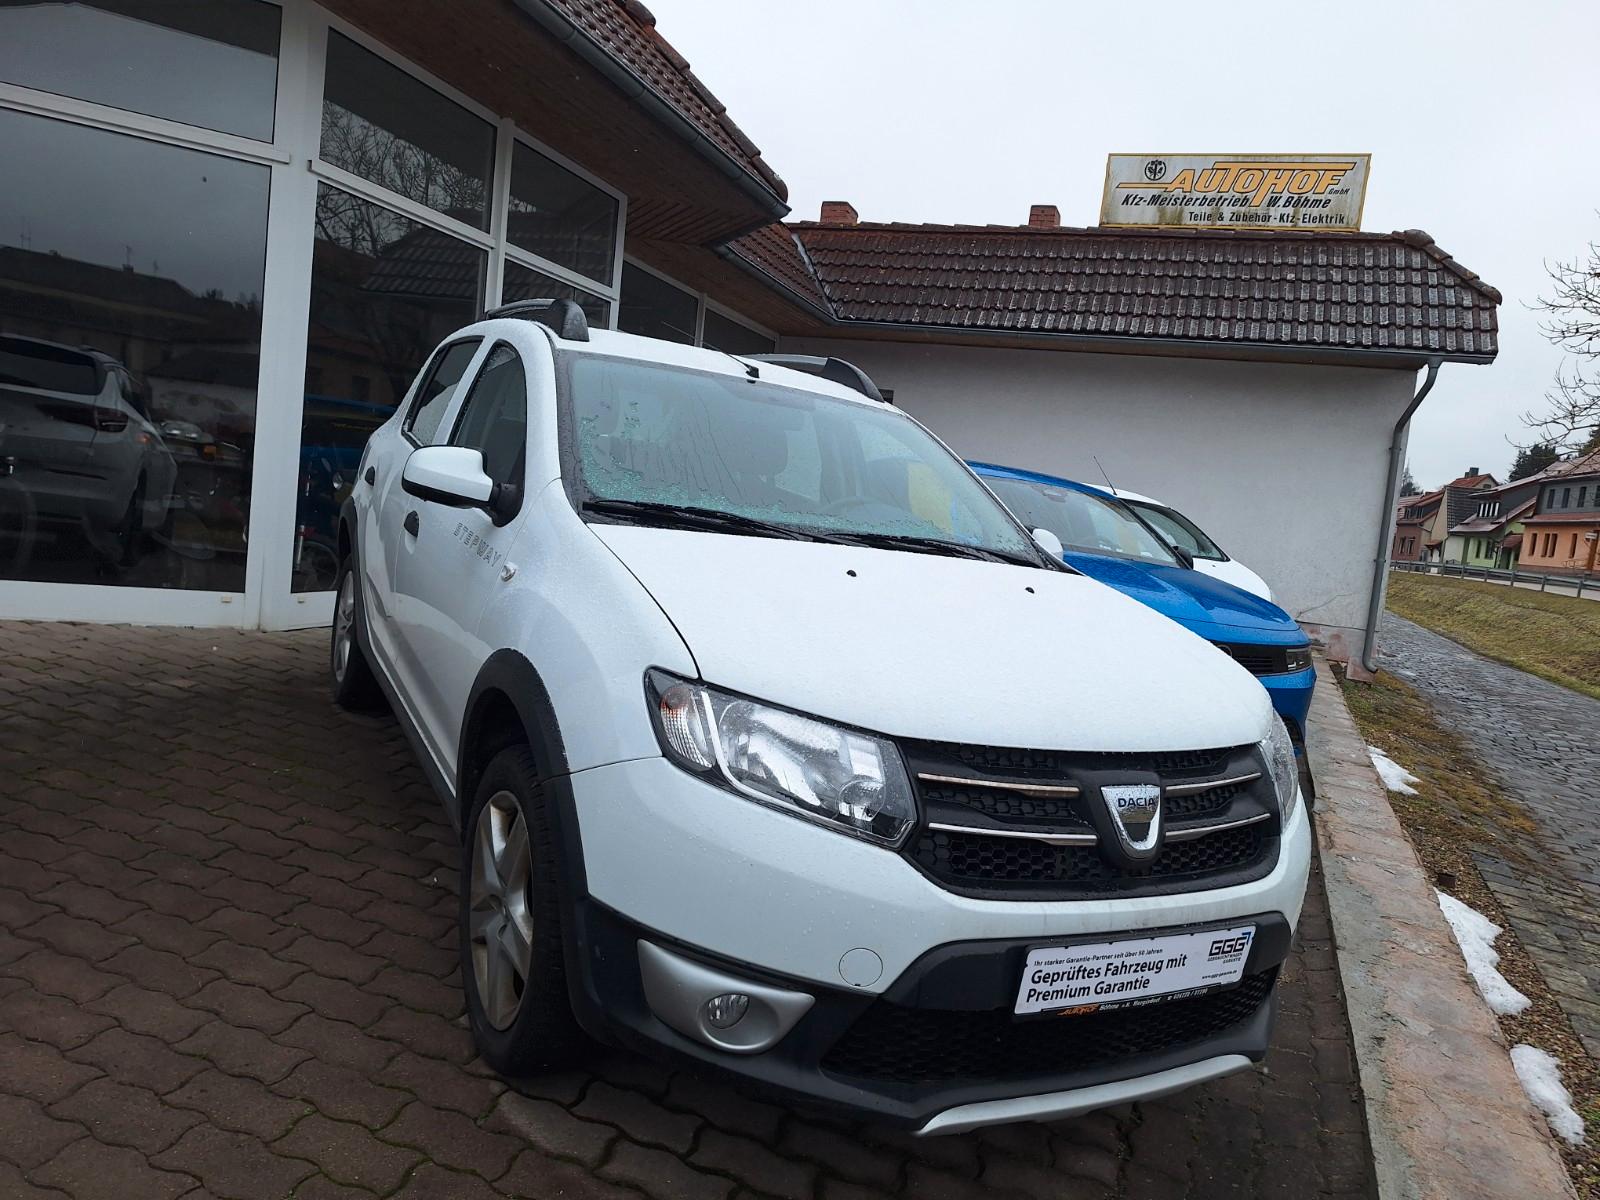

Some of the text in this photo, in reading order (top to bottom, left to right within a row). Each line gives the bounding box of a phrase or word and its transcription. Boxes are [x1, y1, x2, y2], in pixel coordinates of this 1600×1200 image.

[1116, 161, 1357, 207] AUTOHOF
[1121, 194, 1250, 208] Kfz-Meisterbetrieb
[1189, 211, 1212, 222] Teile
[1217, 212, 1225, 222] &
[453, 522, 502, 567] STEPWAY
[1117, 797, 1156, 808] DACIA
[1208, 936, 1248, 957] GGG
[1031, 954, 1187, 987] Geprüftes Fahrzeug mit
[1026, 984, 1091, 1003] Premium
[1094, 975, 1150, 995] Garantie
